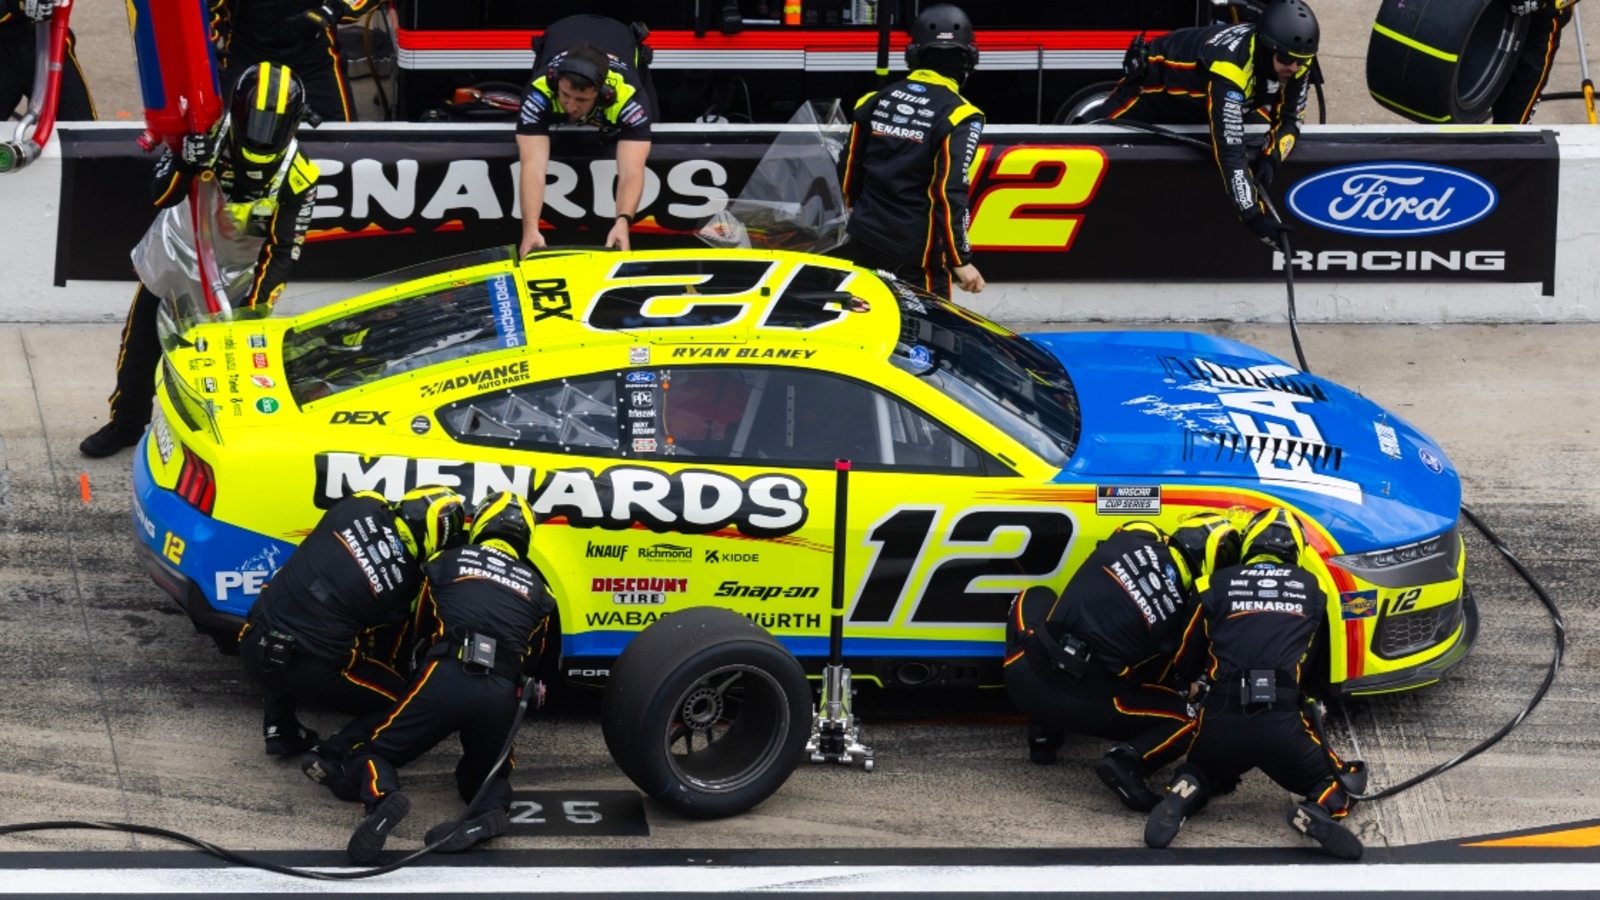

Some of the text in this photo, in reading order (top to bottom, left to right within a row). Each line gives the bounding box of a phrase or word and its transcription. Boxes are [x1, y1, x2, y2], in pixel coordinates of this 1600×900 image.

[312, 157, 729, 222] ENARDS
[1327, 173, 1456, 221] Ford
[1271, 250, 1506, 271] RACING
[494, 274, 519, 348] FORD RACING
[526, 278, 574, 323] DEX
[671, 346, 817, 359] RYAN BLANEY
[441, 360, 530, 393] ADVANCE
[477, 373, 531, 391] AUTO PARTS
[329, 411, 391, 425] DEX
[318, 451, 806, 533] MENARDS
[1116, 487, 1152, 497] NASCAR
[1105, 499, 1153, 508] CUP SERIES
[162, 530, 186, 566] 12
[638, 544, 693, 559] Richmond
[722, 553, 760, 562] KIDDE
[342, 528, 384, 593] MENARDS
[848, 504, 1079, 627] 12
[459, 566, 529, 594] MENARDS
[1240, 569, 1292, 577] FRANCE
[215, 569, 274, 601] PE
[591, 577, 689, 593] DISCOUNT
[714, 580, 820, 601] Snap-on
[1111, 561, 1157, 624] MENARDS
[618, 594, 660, 604] TIRE
[1231, 601, 1303, 613] MENARDS
[1390, 587, 1422, 614] 12
[586, 611, 672, 627] WABA
[568, 669, 611, 677] FOR
